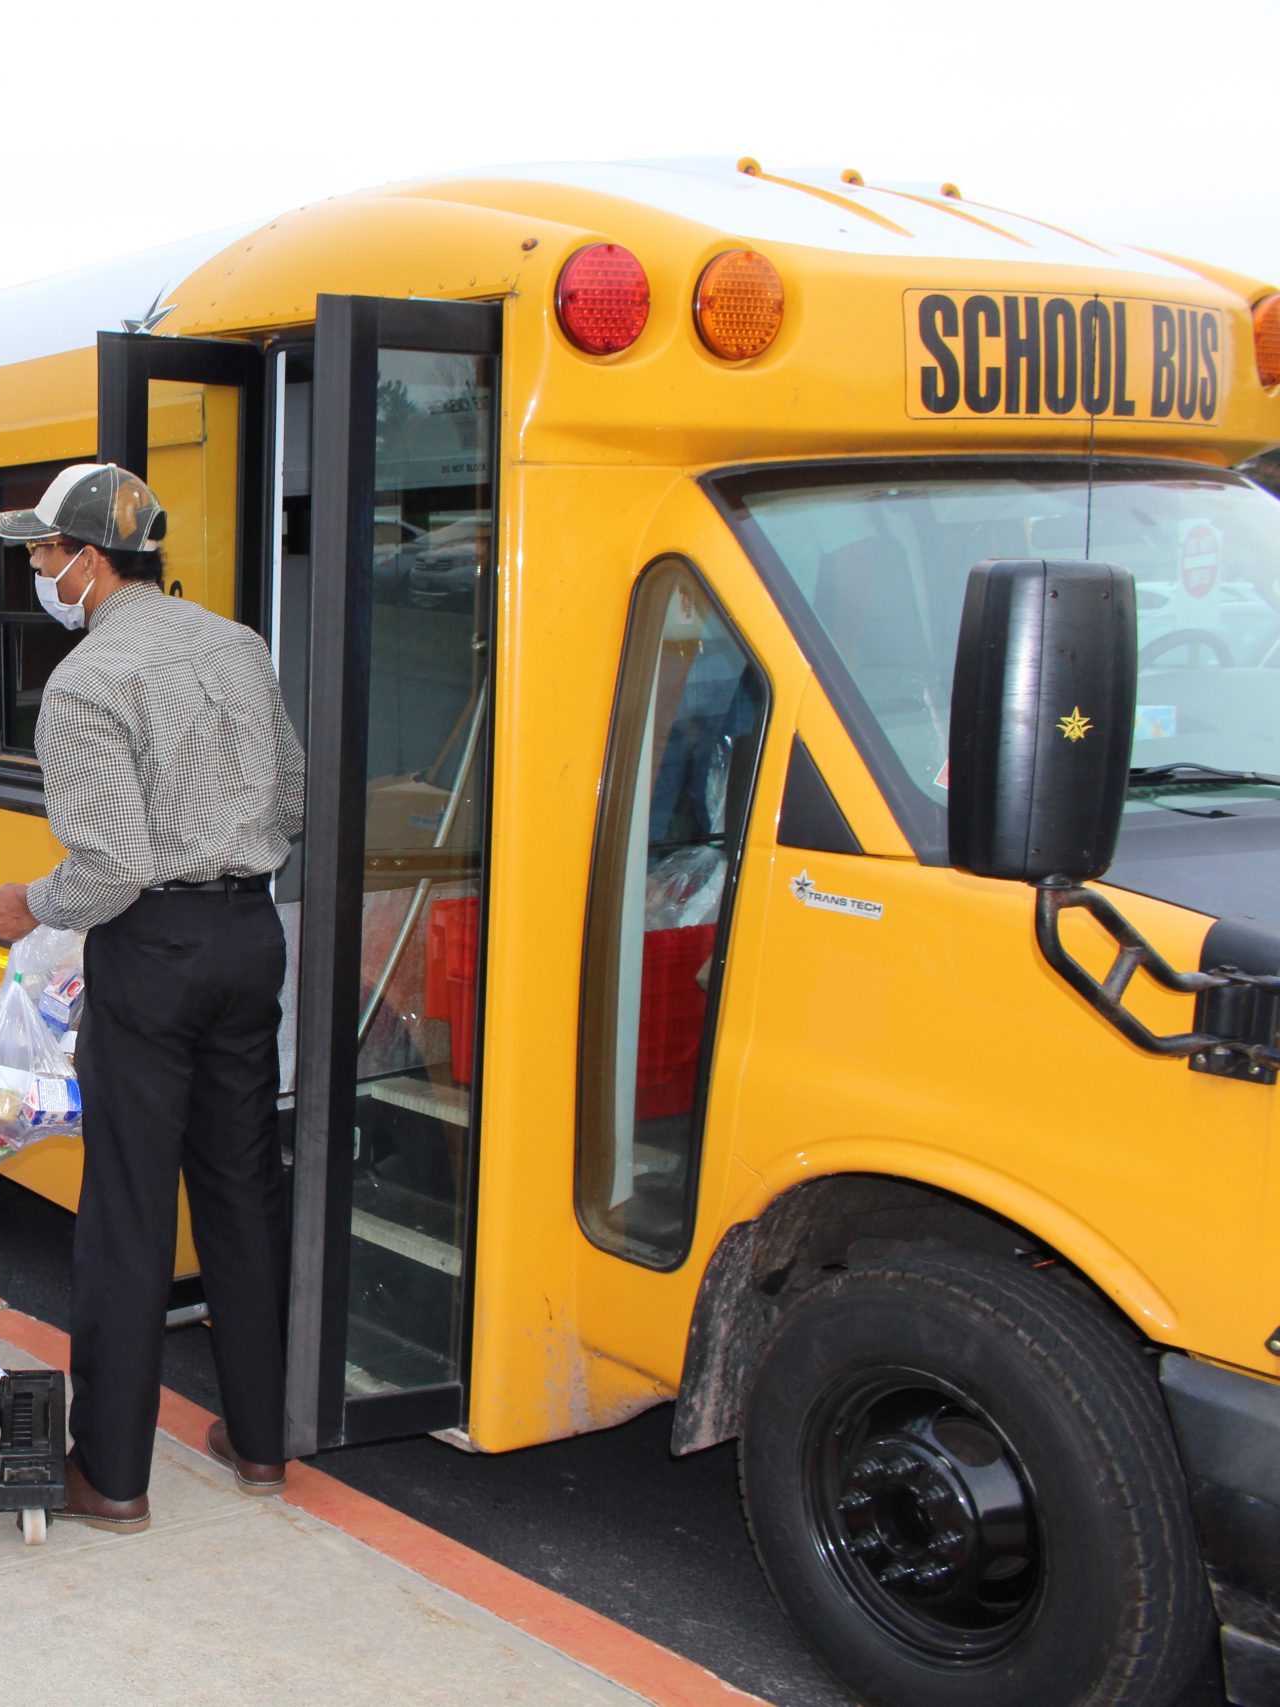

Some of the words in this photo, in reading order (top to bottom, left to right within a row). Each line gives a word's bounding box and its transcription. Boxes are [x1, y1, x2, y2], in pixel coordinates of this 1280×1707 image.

[918, 294, 1135, 416] SCHOOL
[1150, 304, 1218, 421] BUS
[808, 891, 847, 906] TRANS
[850, 900, 882, 913] TECH
